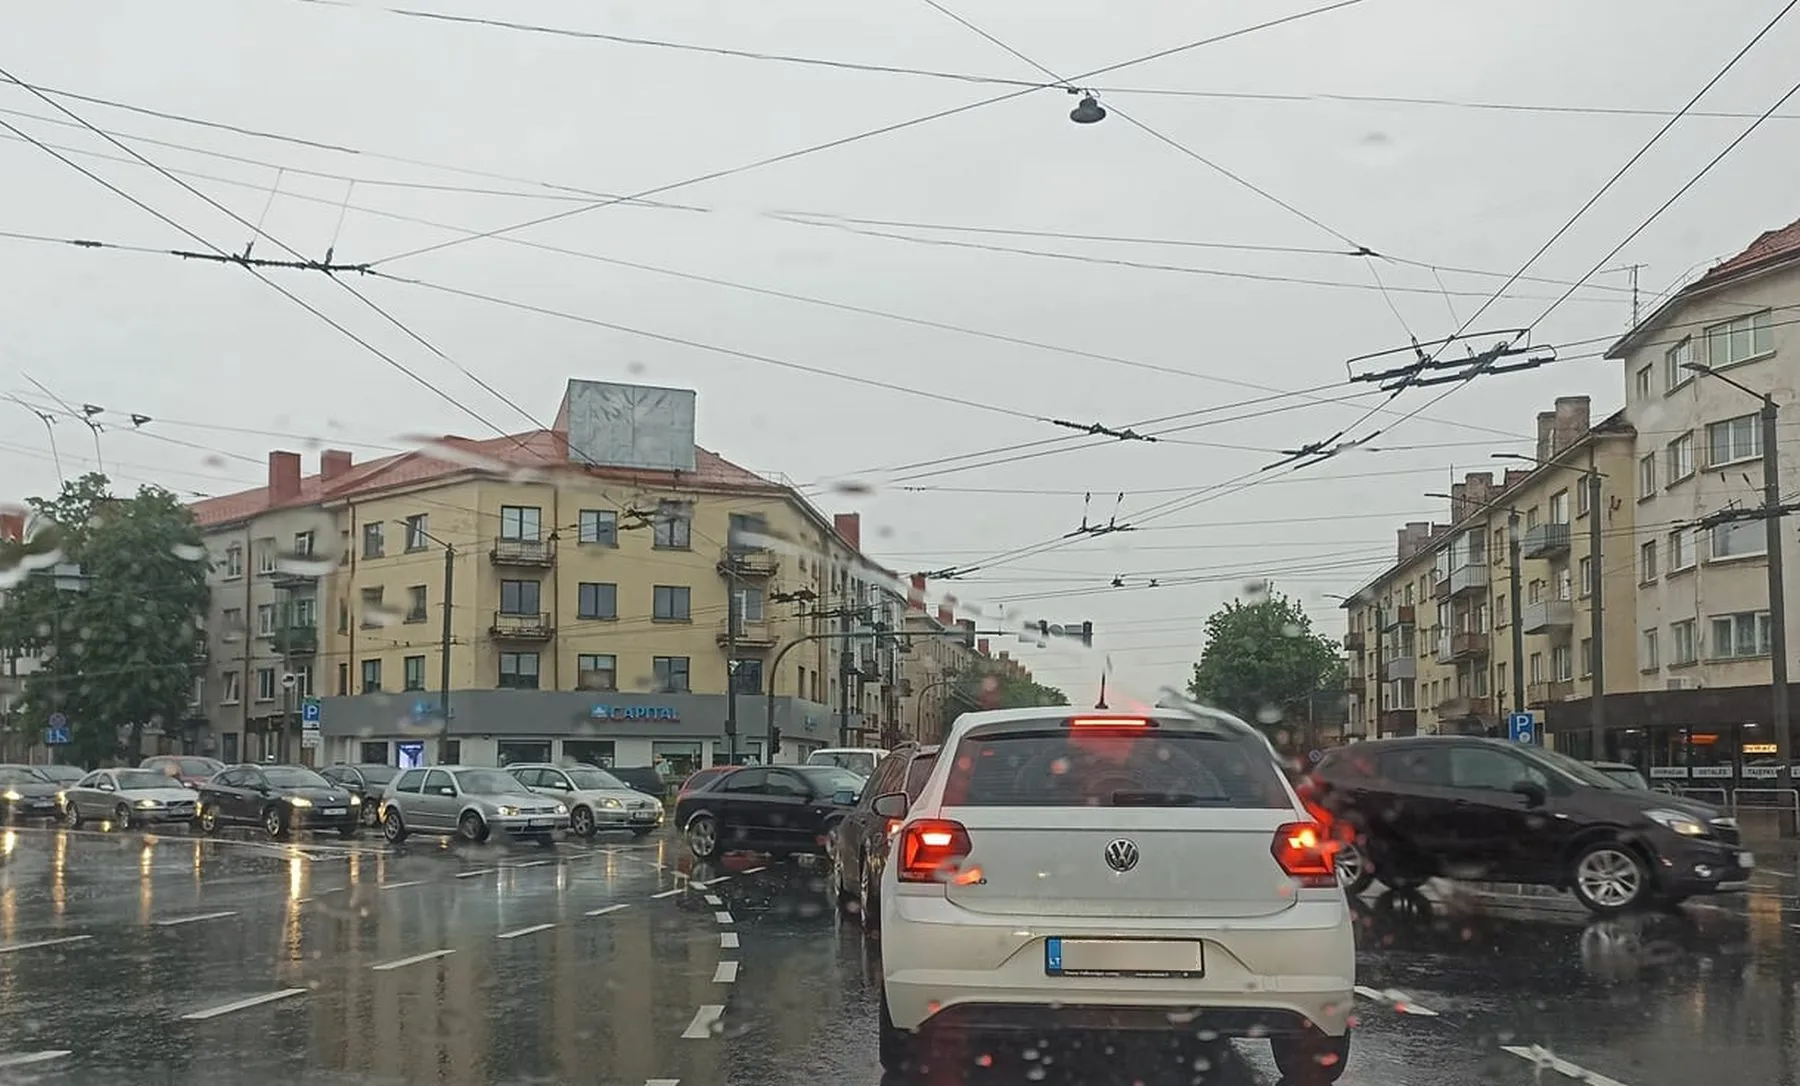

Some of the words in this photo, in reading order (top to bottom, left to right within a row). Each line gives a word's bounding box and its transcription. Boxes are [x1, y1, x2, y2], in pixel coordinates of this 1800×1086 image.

[307, 704, 318, 720] P
[610, 707, 680, 721] CAPITAL
[1516, 715, 1529, 732] P
[1049, 957, 1060, 965] LT
